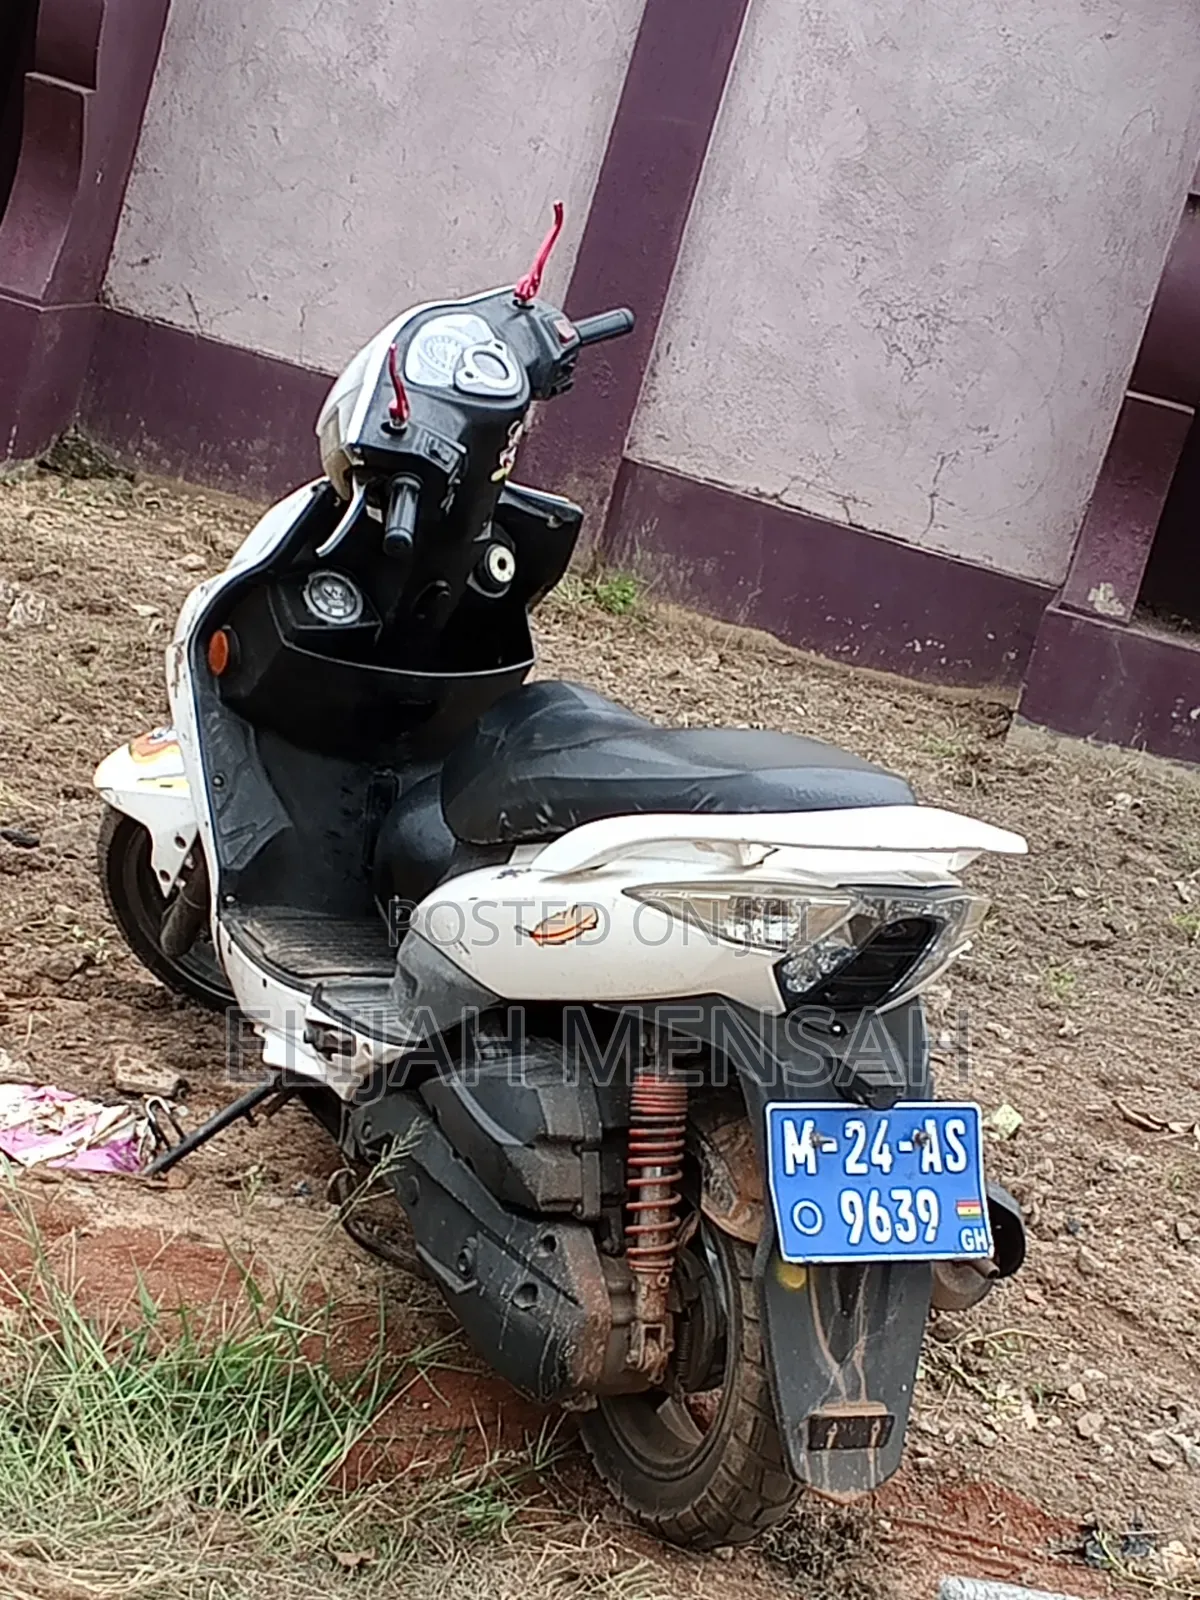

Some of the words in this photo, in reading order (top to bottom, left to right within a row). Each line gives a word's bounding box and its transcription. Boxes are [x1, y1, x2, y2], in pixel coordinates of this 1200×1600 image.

[783, 1118, 967, 1175] M-24-AS
[839, 1188, 940, 1245] 9639
[959, 1226, 989, 1252] GH
